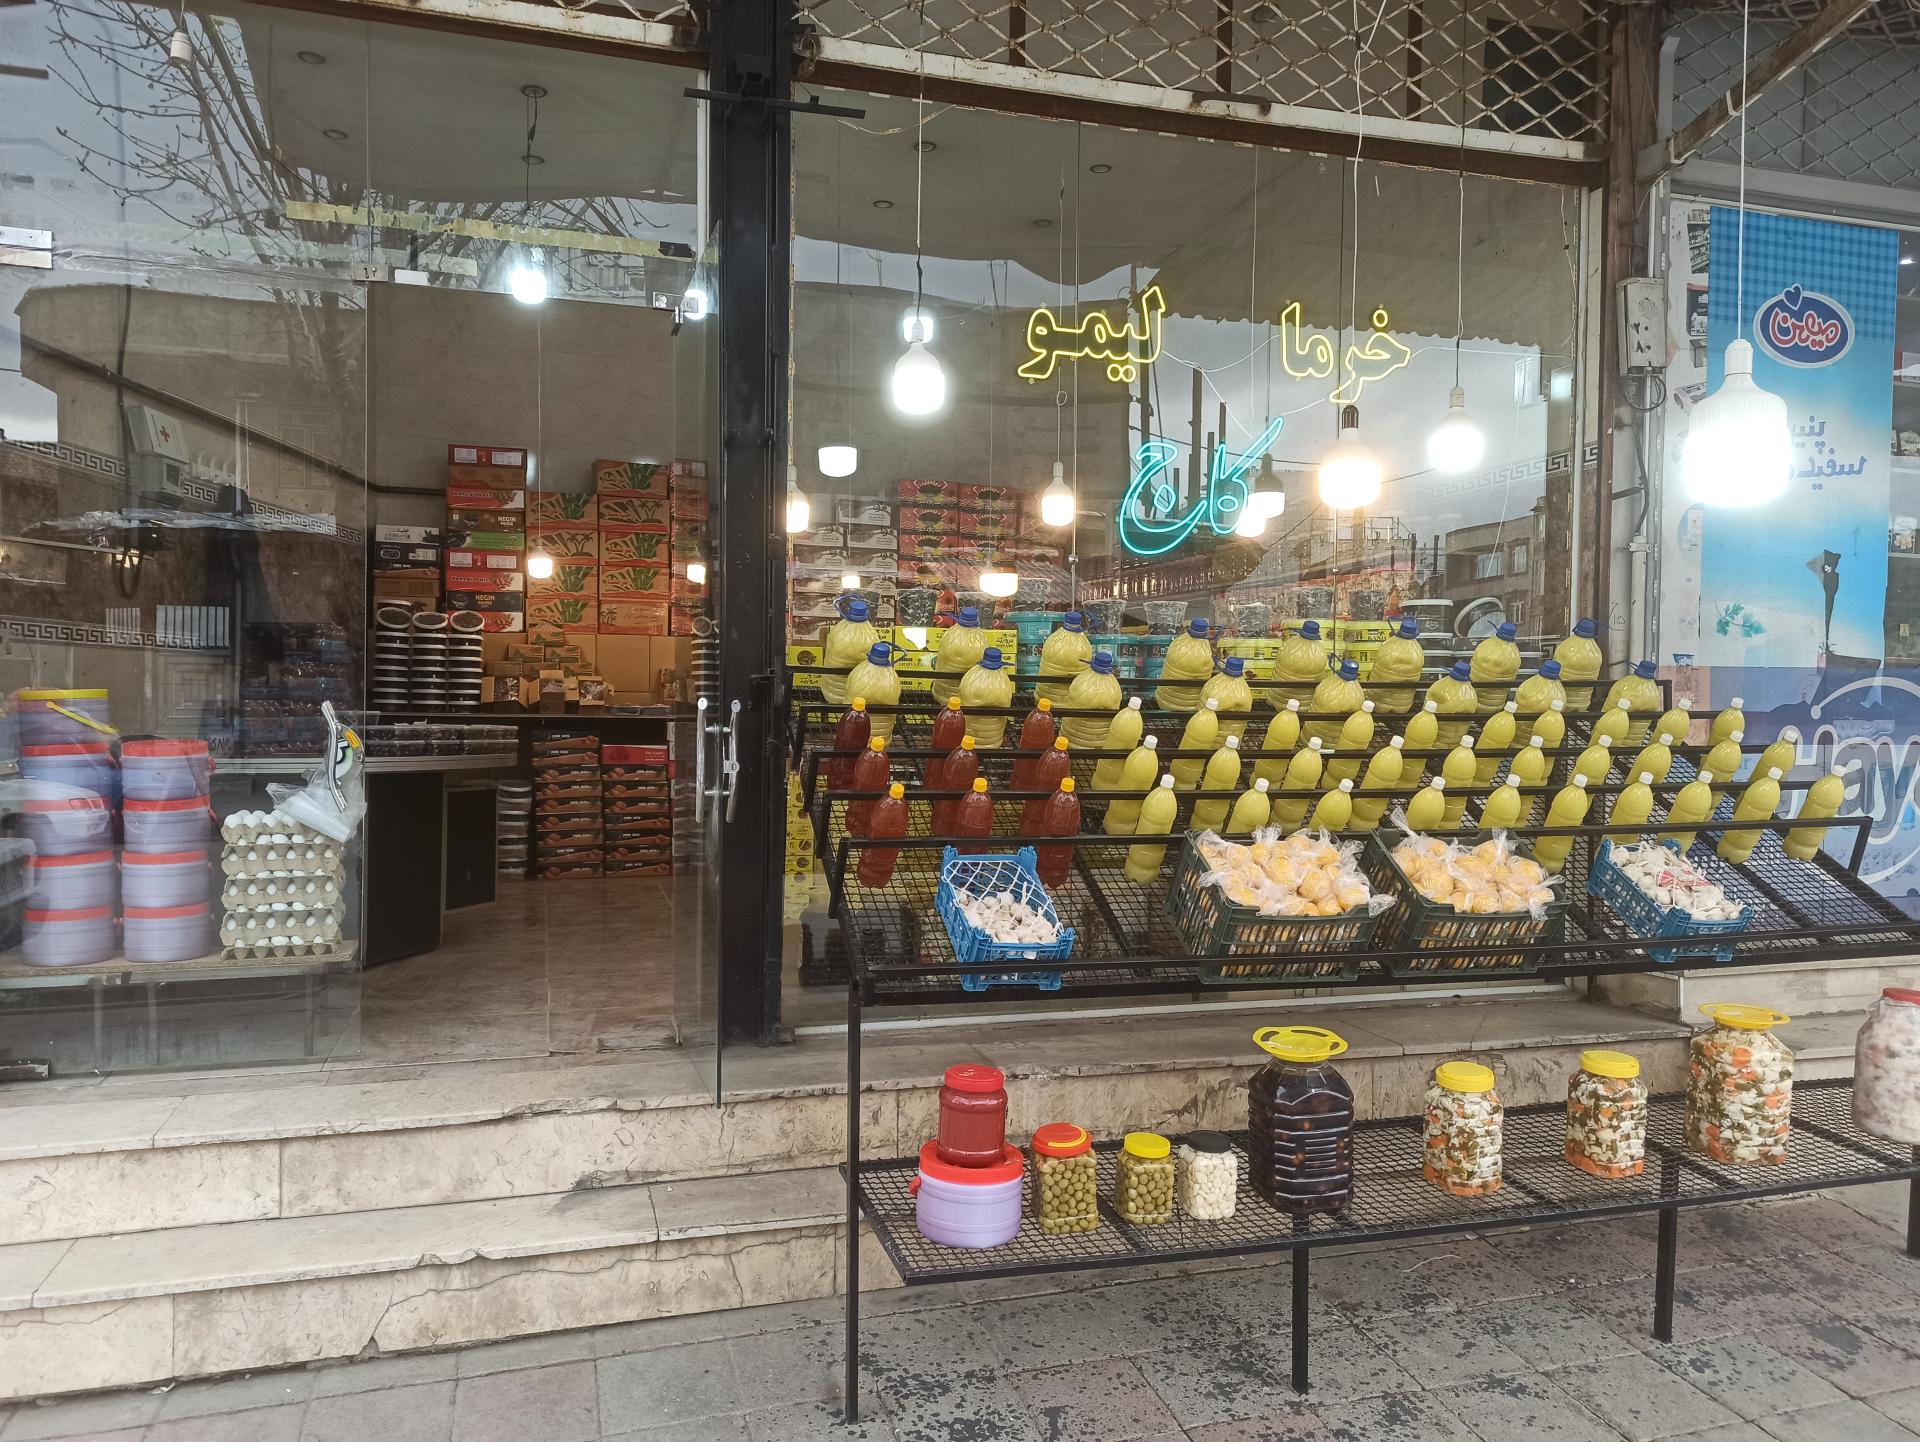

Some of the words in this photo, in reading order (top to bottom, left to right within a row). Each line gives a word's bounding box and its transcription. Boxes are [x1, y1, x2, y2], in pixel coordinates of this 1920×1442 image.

[1017, 286, 1166, 383] لیمو
[1279, 300, 1412, 404] خرما
[1769, 307, 1841, 352] میهن
[1791, 415, 1827, 455] پنی
[1777, 725, 1920, 845] Hay
